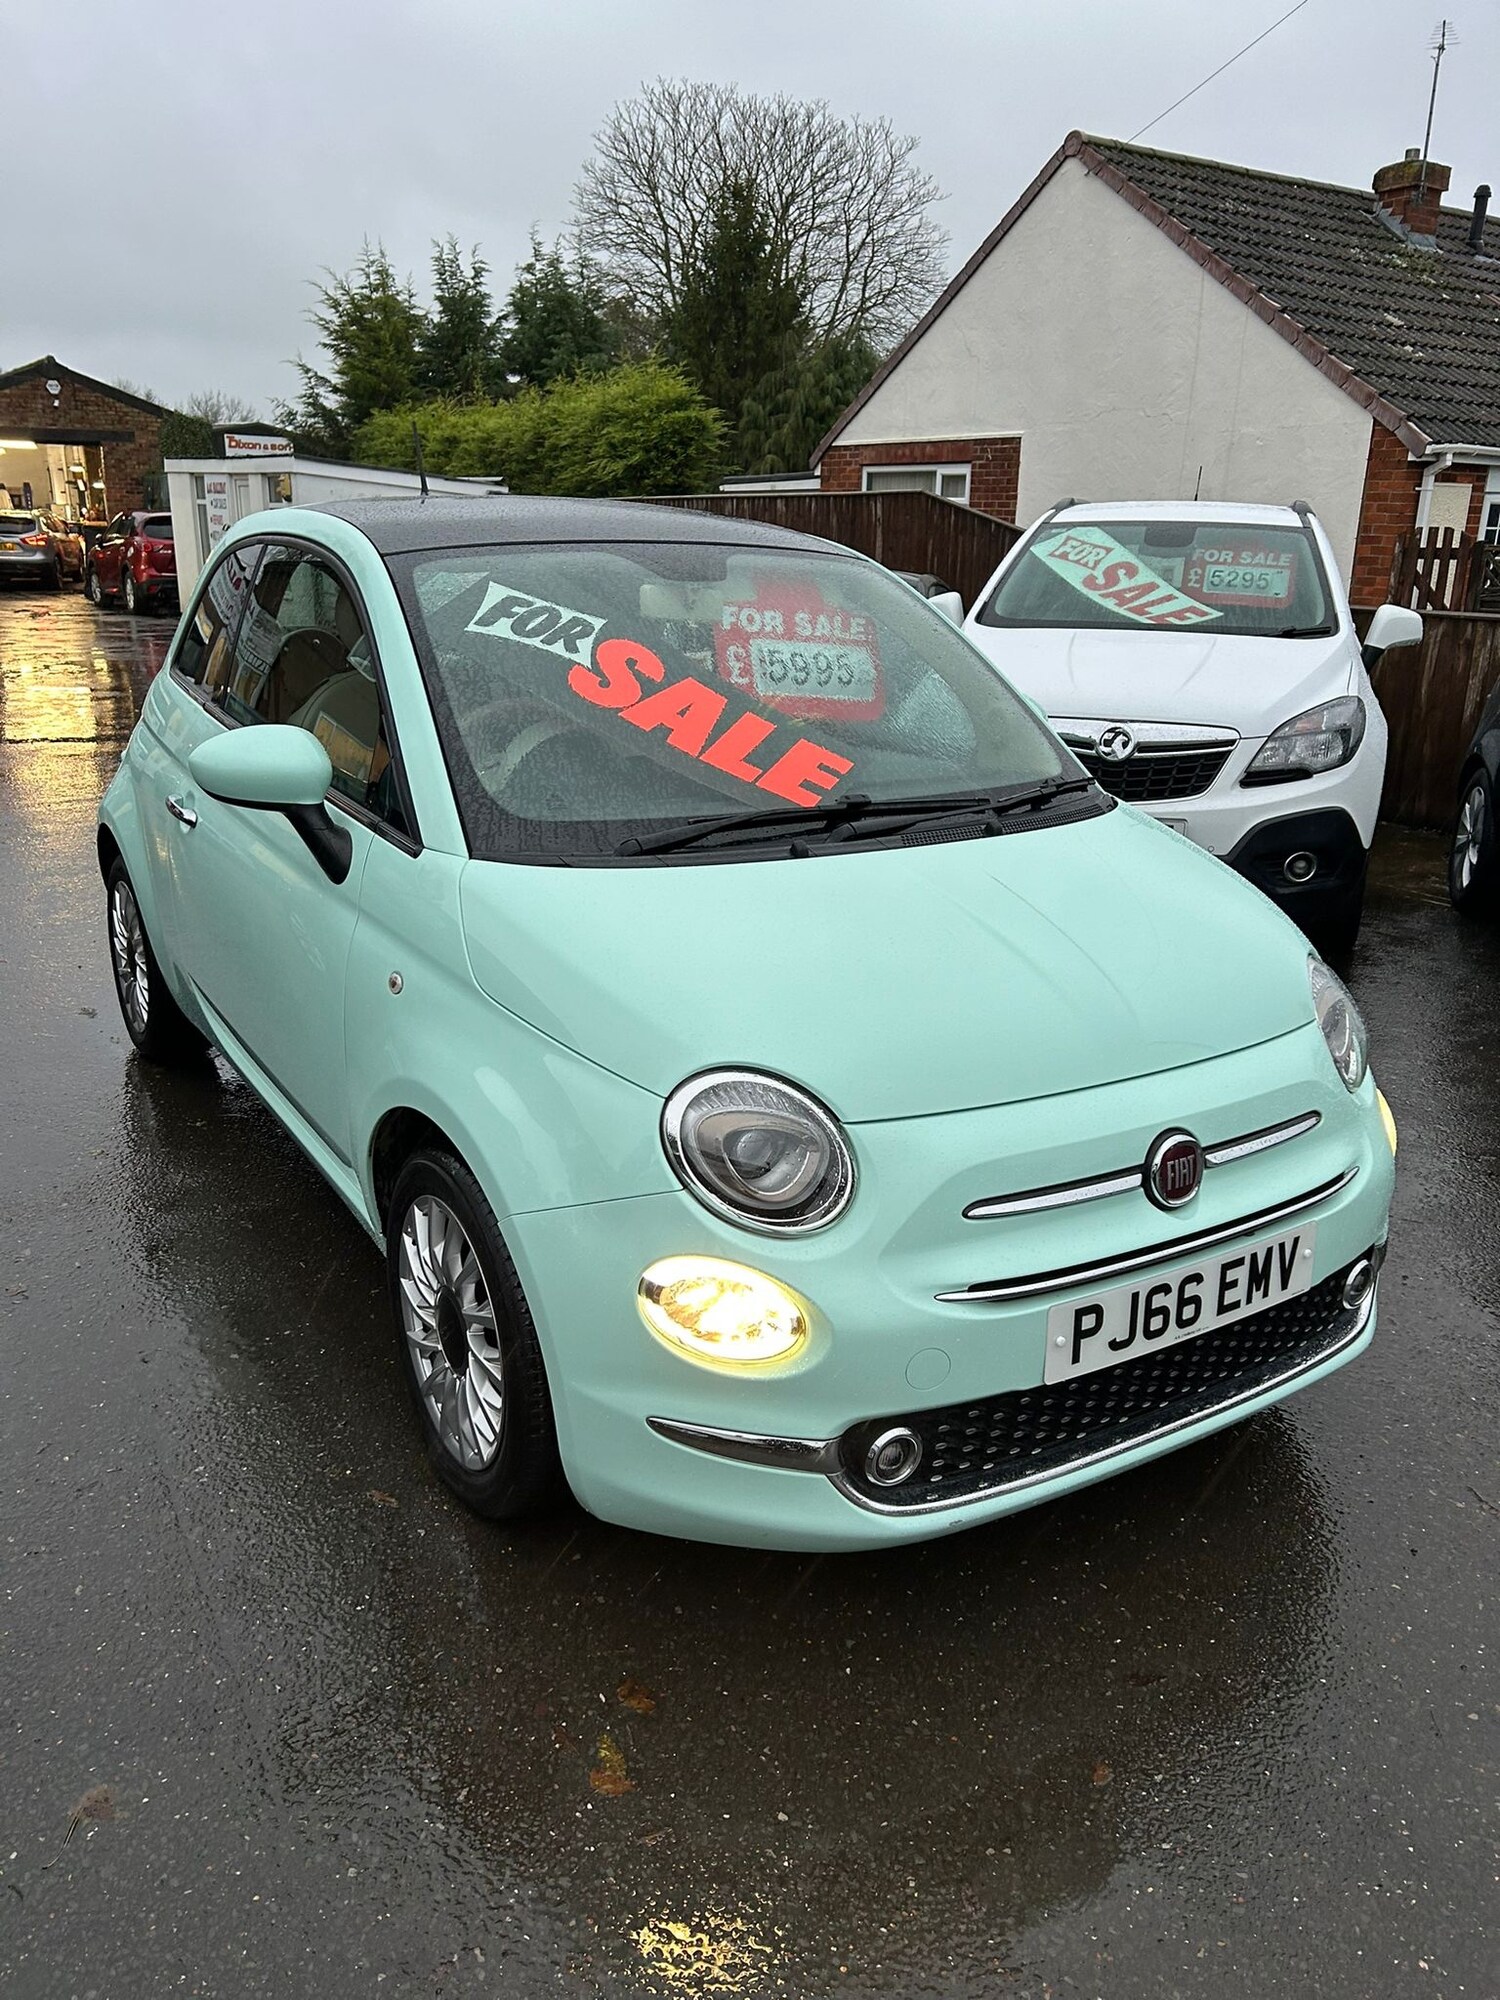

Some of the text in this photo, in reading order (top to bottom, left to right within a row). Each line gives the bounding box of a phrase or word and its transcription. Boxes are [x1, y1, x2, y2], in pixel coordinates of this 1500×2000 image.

[1192, 549, 1293, 566] FOR SALE
[1054, 538, 1212, 624] FOR SALE
[1188, 568, 1269, 590] £ 5295
[721, 605, 869, 640] FOR SALE
[726, 643, 749, 685] £
[473, 596, 855, 808] FOR SALE
[1166, 1155, 1196, 1191] FIAT
[1070, 1236, 1301, 1365] PJ66 EMV
